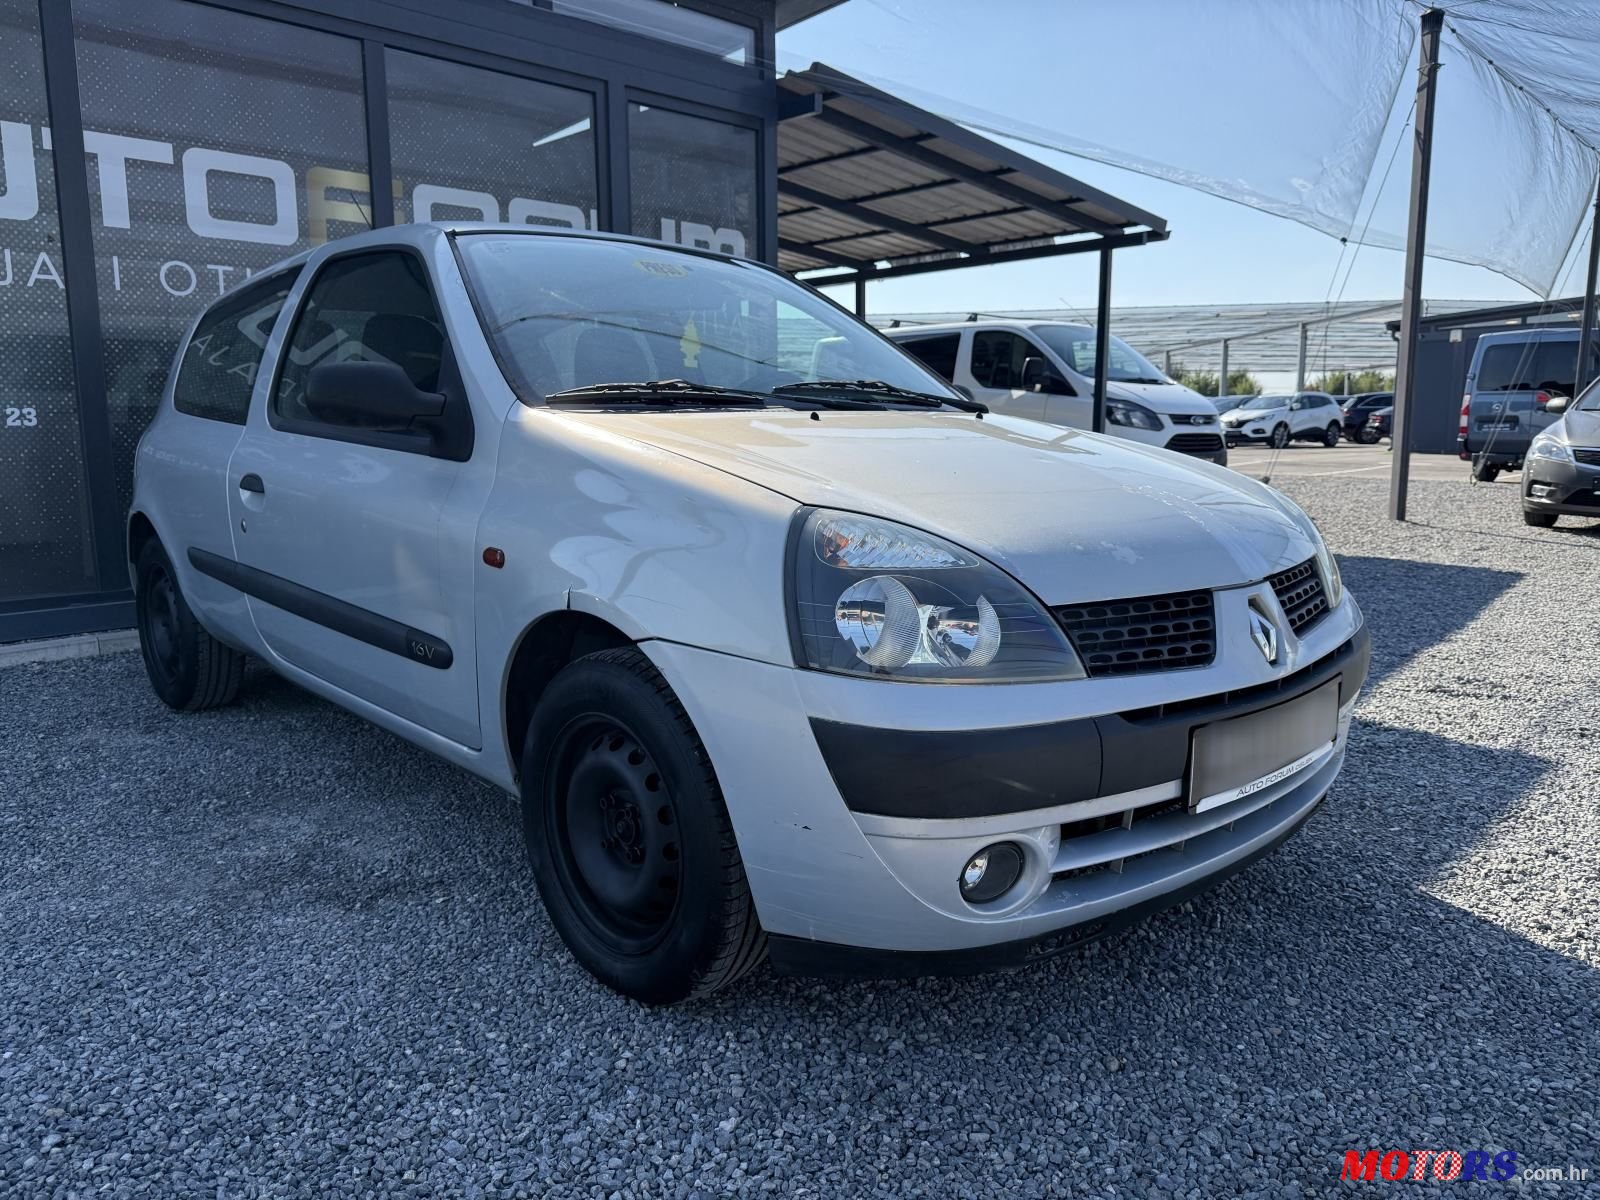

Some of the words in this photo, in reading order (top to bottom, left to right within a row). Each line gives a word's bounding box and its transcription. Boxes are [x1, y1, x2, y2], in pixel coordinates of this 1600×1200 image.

[112, 255, 121, 291] I
[160, 260, 252, 296] OT
[5, 407, 38, 427] 23
[411, 641, 435, 659] 16V
[1236, 780, 1264, 798] AUTO
[1264, 765, 1295, 787] FORUM
